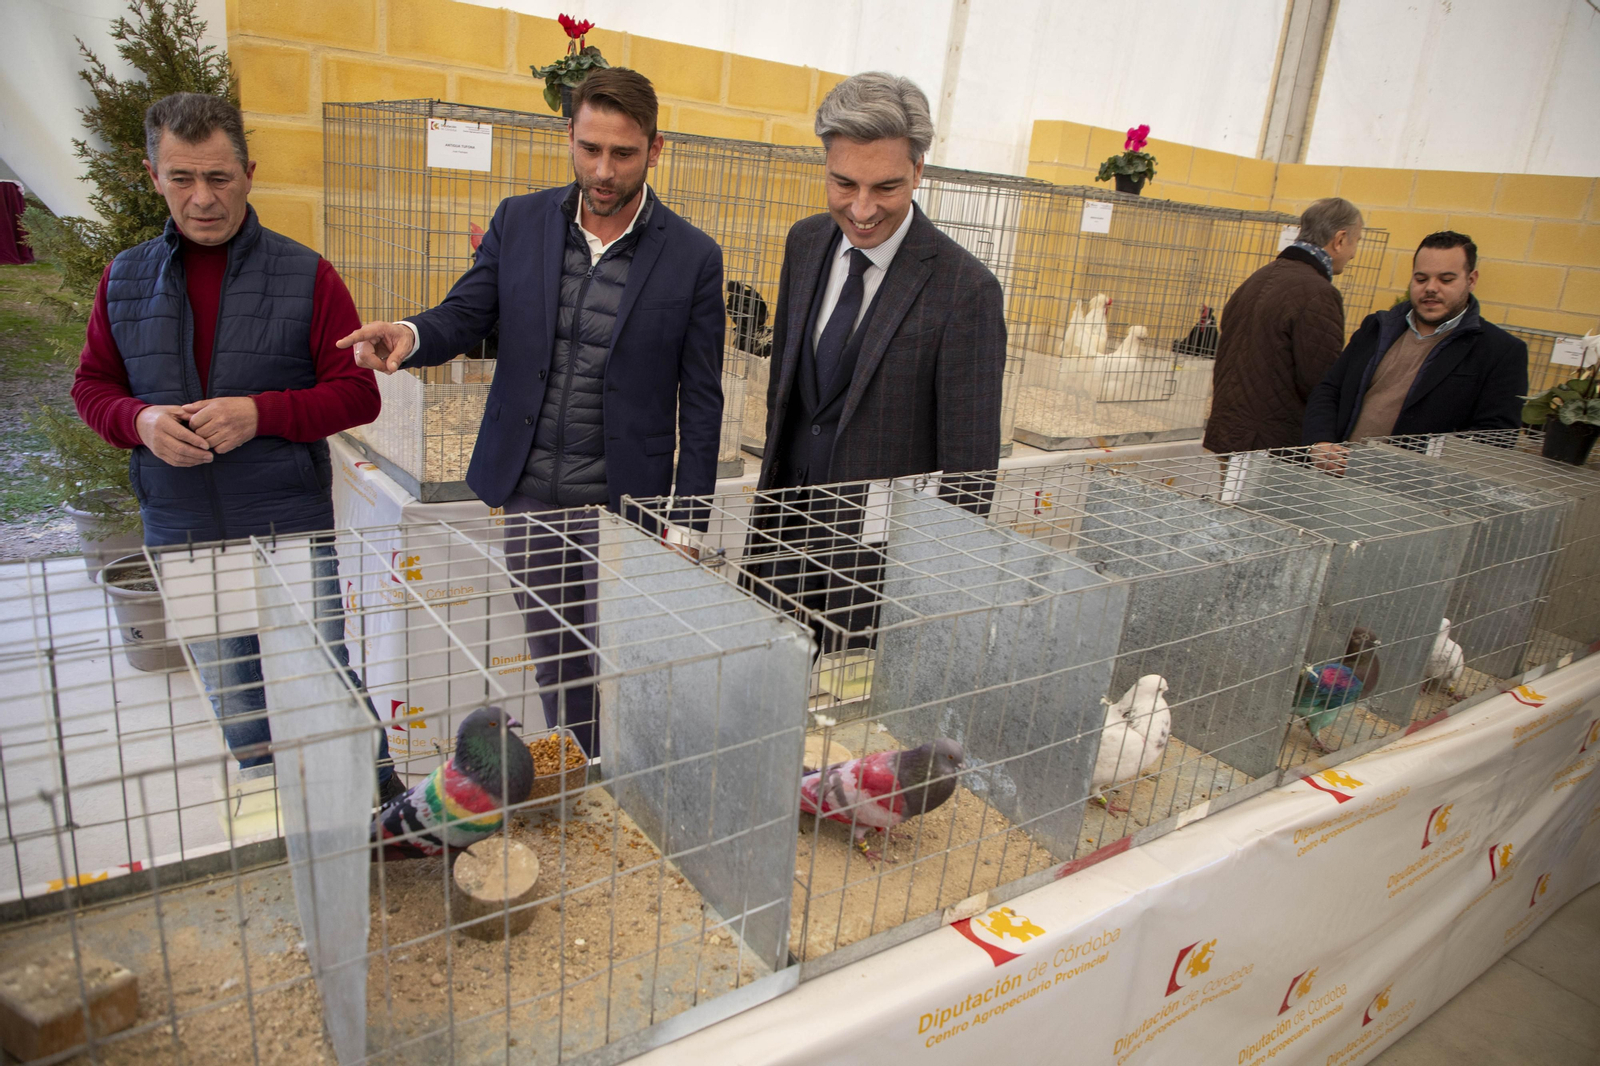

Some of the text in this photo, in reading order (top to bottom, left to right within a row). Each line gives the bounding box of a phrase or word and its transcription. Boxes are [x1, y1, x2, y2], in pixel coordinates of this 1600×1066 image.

[412, 738, 426, 747] de
[917, 927, 1121, 1034] Diputación de Córdoba
[925, 950, 1110, 1048] Centro Agropecuario Provincial
[1113, 999, 1180, 1056] Diputación
[1182, 989, 1199, 1006] de
[1238, 1018, 1291, 1065] Diputación
[1294, 1010, 1306, 1025] de
